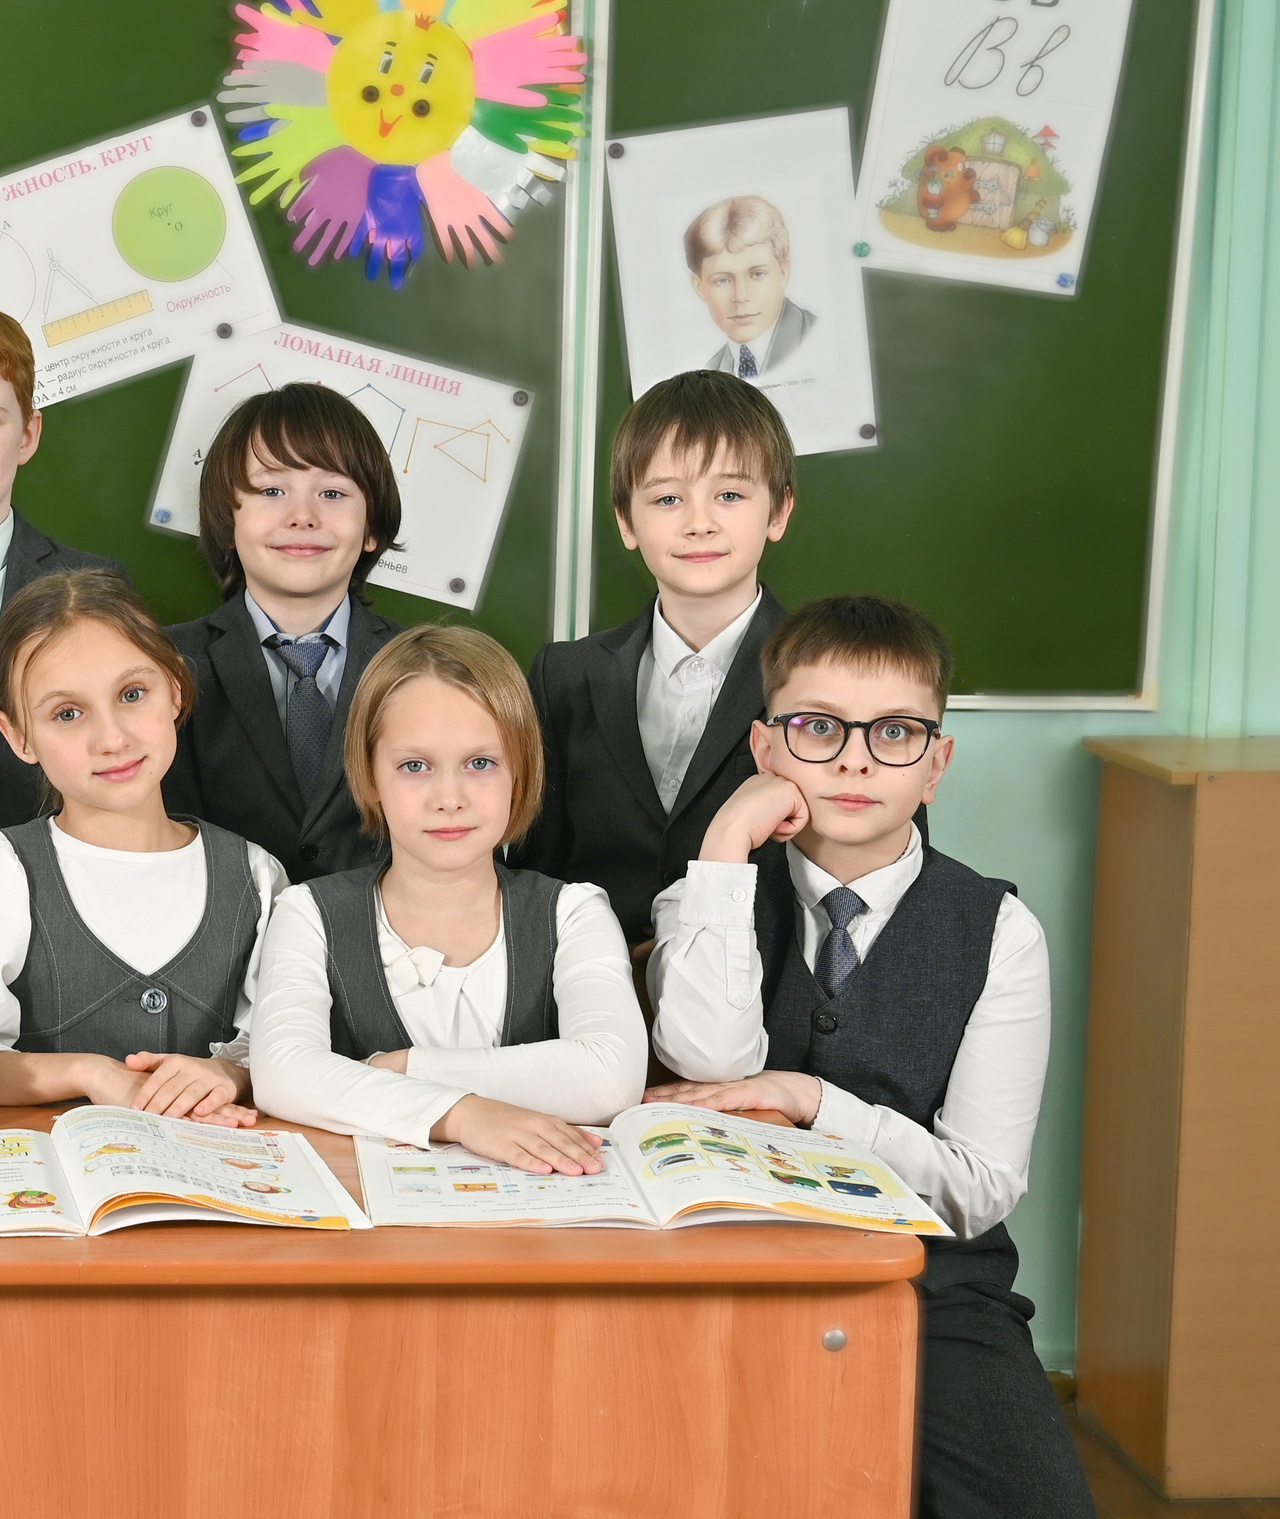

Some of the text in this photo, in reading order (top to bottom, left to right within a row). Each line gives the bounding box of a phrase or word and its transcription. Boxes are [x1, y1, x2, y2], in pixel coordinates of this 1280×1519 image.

[99, 135, 154, 167] КРУГ
[148, 203, 173, 219] Круг
[166, 284, 232, 312] Окружность
[44, 358, 70, 373] центр
[71, 339, 121, 363] окружности
[129, 327, 154, 343] круга
[57, 366, 87, 385] радиус
[88, 349, 138, 372] окружности
[147, 336, 171, 352] круга
[273, 331, 462, 397] ЛОМАНАЯ ЛИНИЯ
[58, 387, 64, 396] 4
[66, 384, 78, 394] см
[377, 558, 408, 574] еньев
